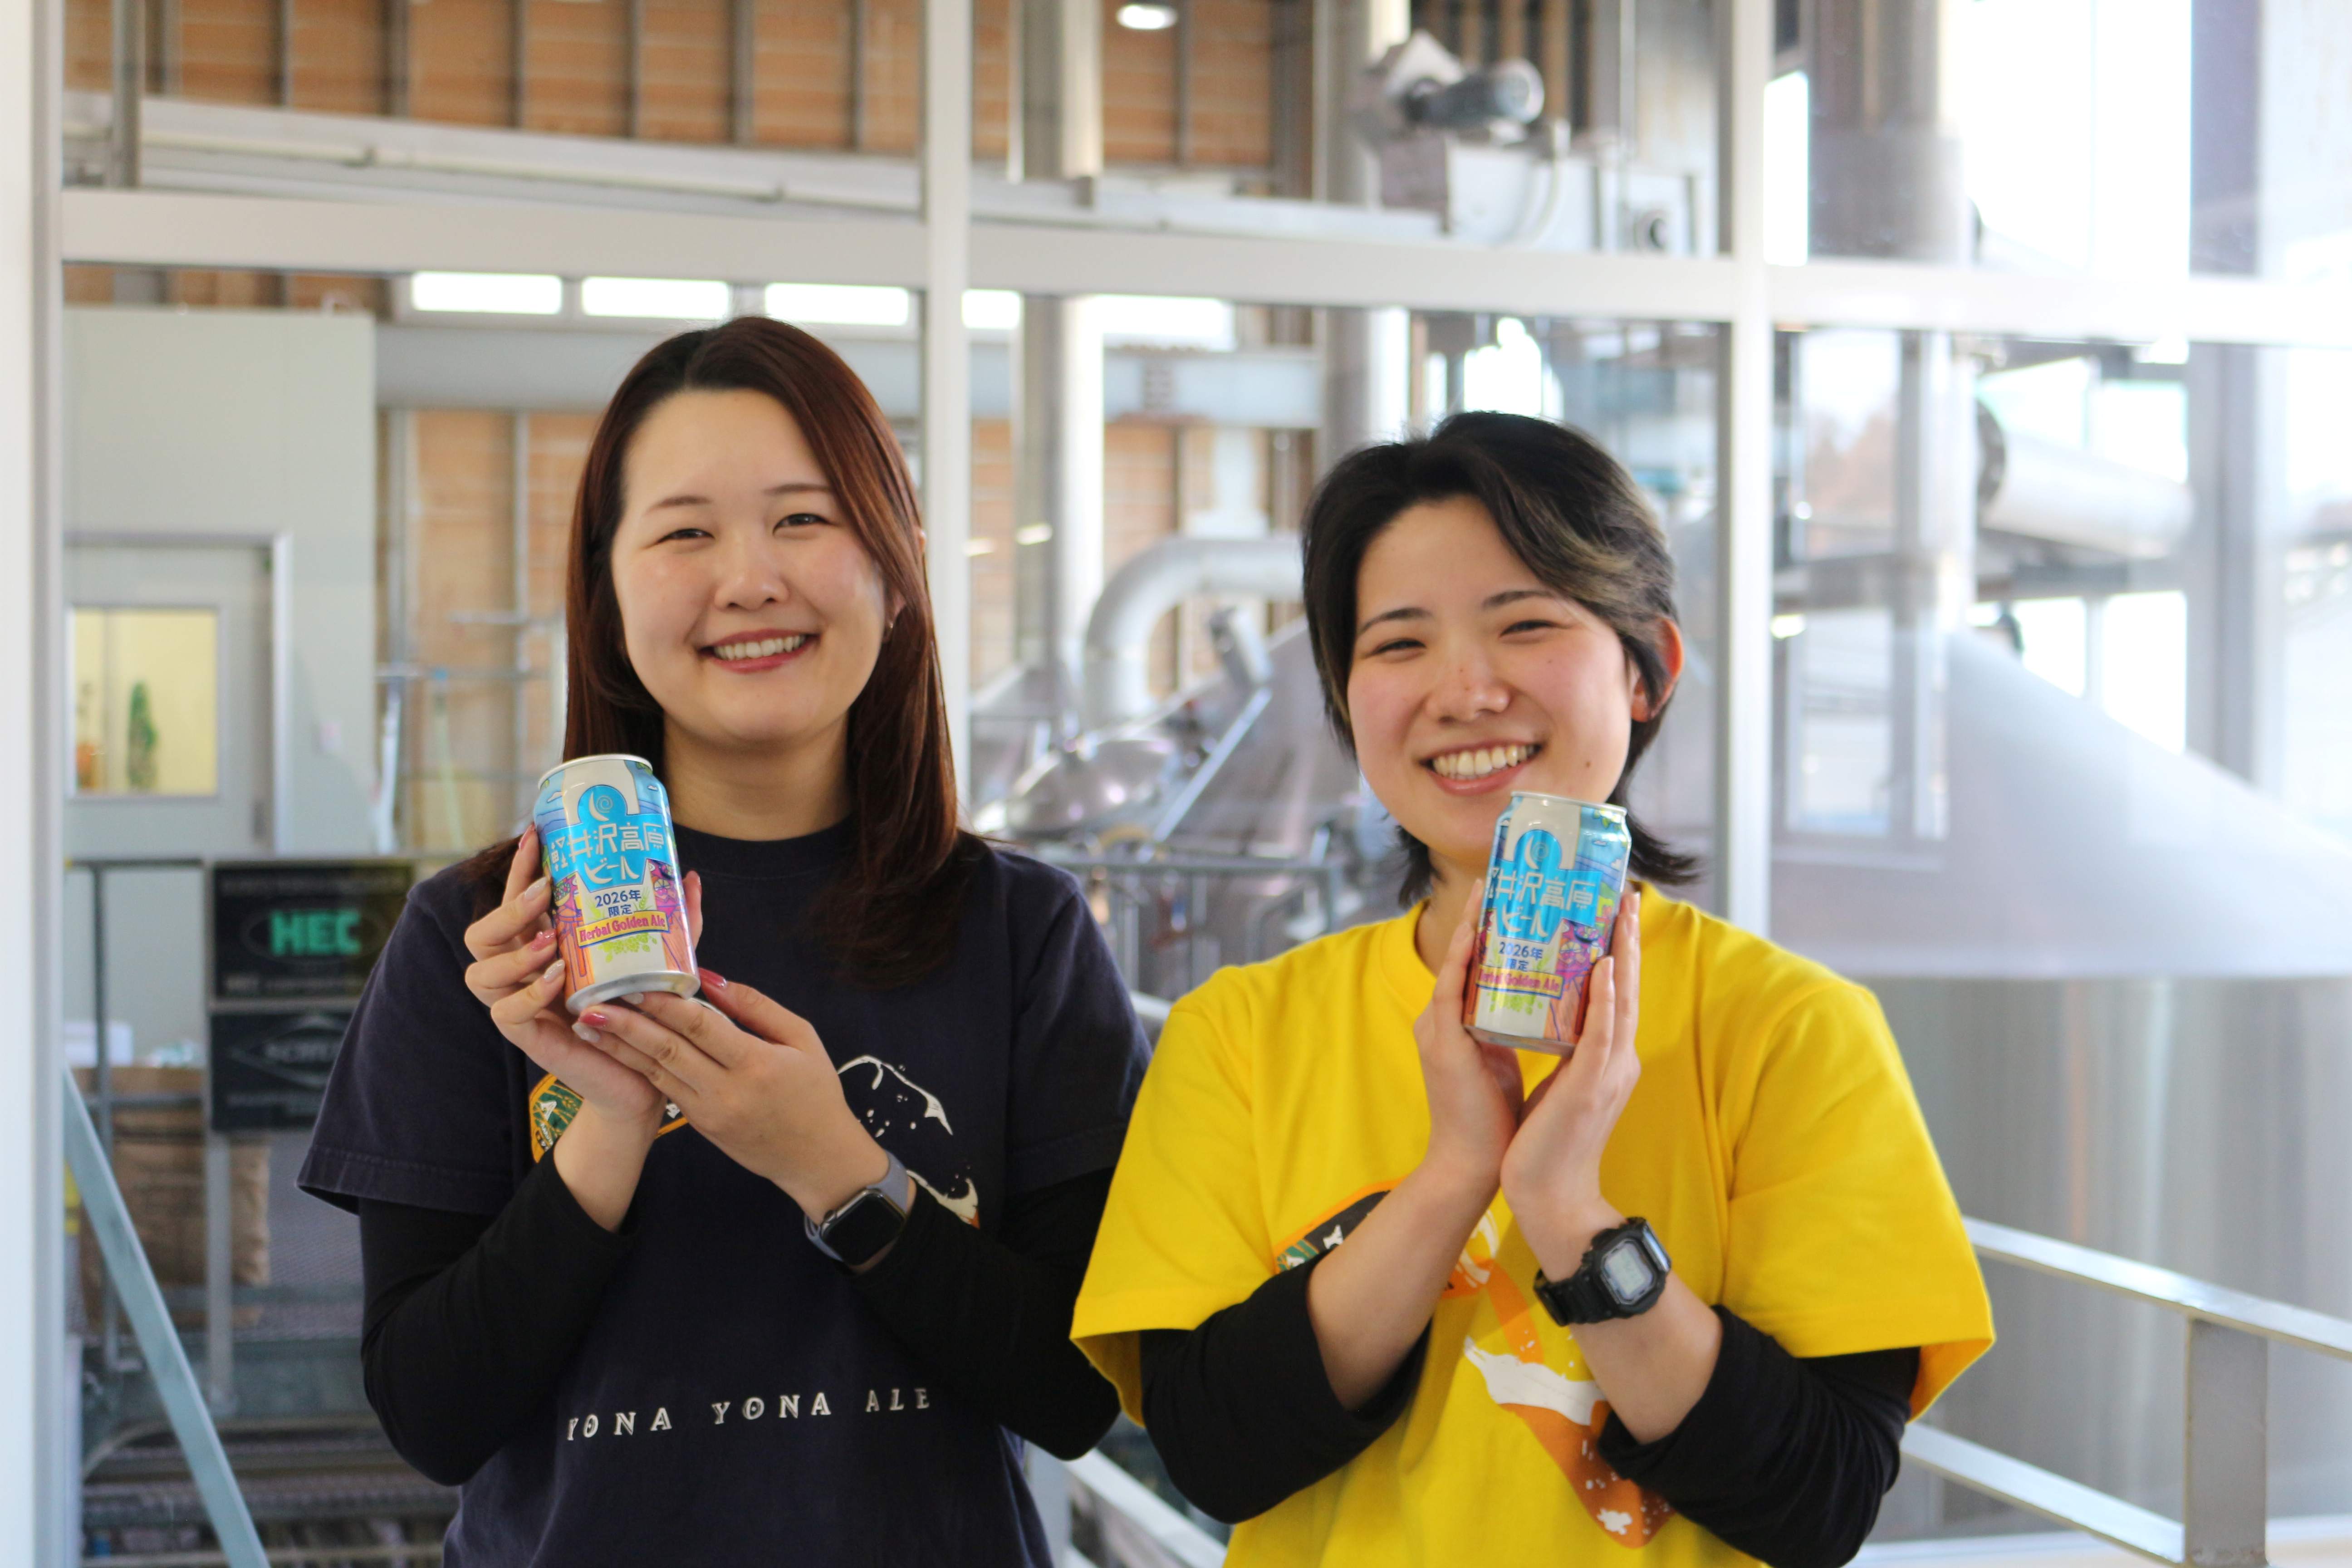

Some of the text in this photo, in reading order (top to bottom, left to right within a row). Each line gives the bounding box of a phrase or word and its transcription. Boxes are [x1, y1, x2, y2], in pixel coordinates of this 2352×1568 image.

[584, 856, 640, 884] ビール
[595, 890, 641, 907] 2026年
[608, 904, 632, 917] 限定
[271, 910, 361, 955] HEC
[579, 914, 666, 942] Herbal Golden Ale
[1502, 904, 1548, 937] ビール
[1499, 941, 1544, 960] 2026年
[1544, 978, 1560, 992] Ale
[567, 1388, 929, 1441] YONA YONA ALE
